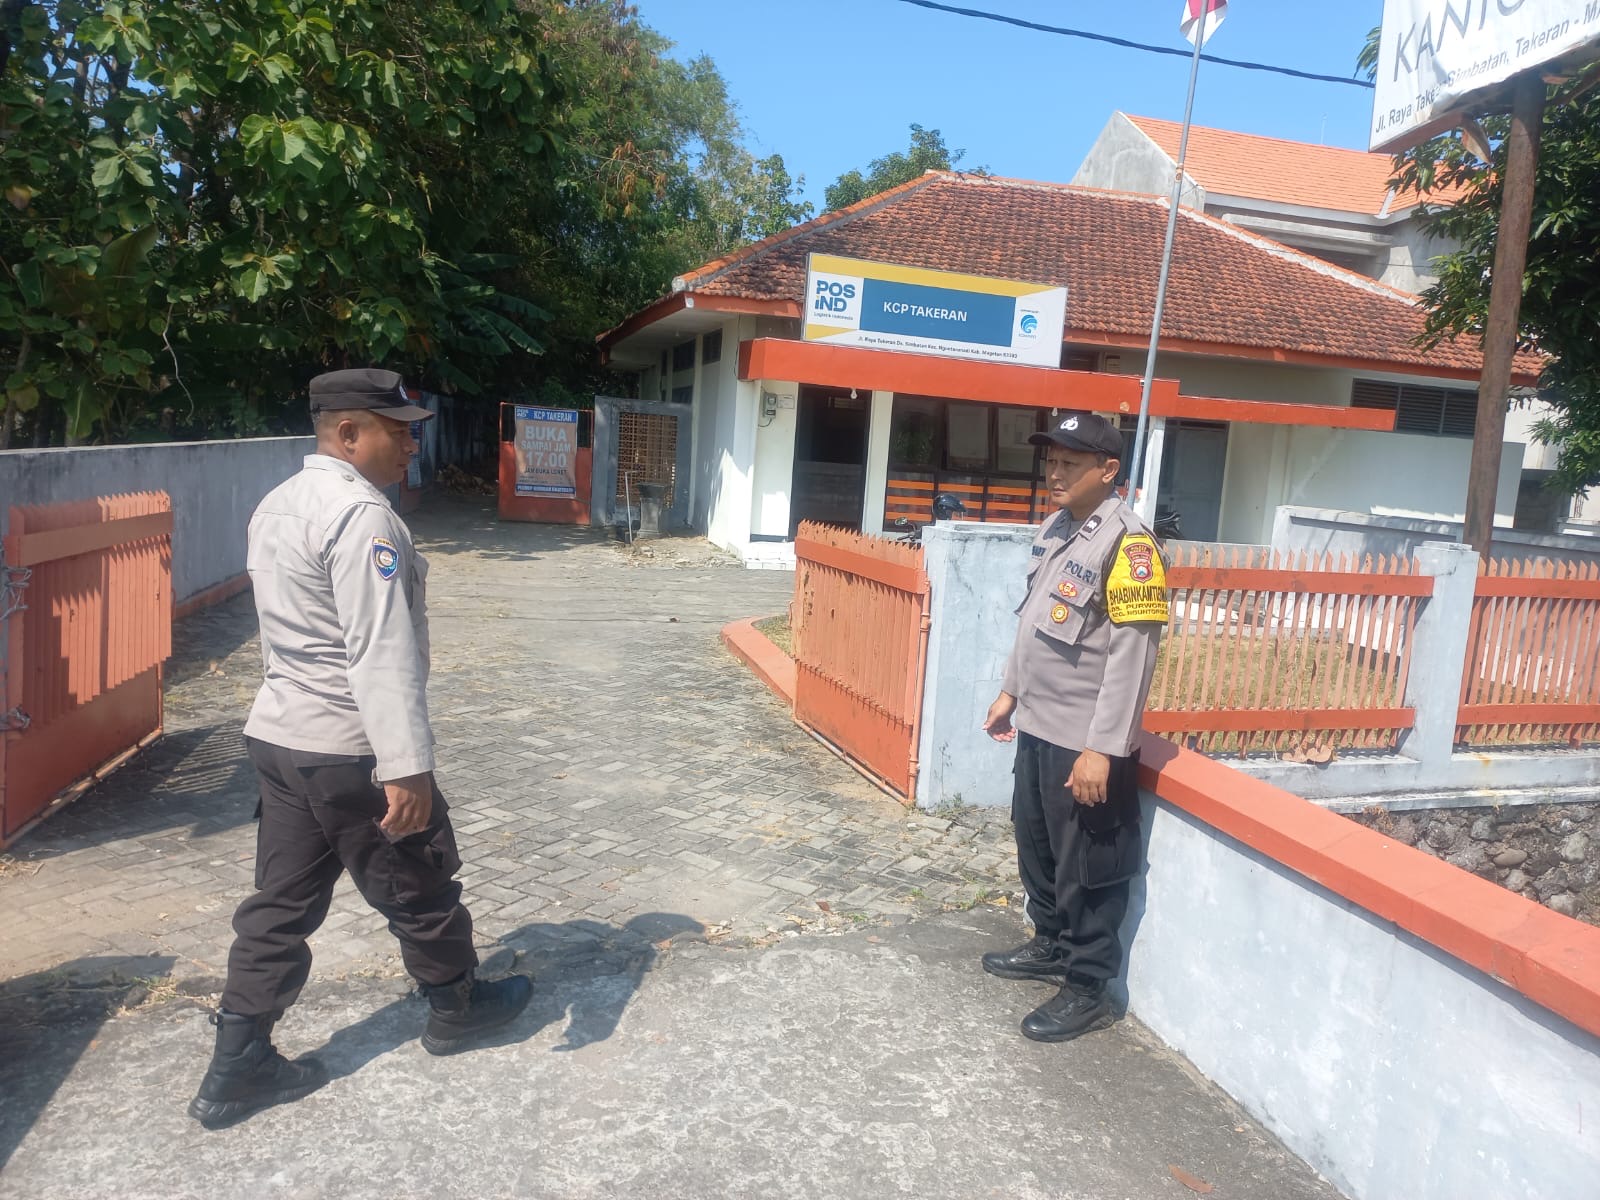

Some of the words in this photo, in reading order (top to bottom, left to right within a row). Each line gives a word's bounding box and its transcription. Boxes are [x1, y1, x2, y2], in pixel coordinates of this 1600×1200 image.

[1375, 115, 1386, 133] Jl.
[1388, 104, 1412, 127] Raya
[1515, 18, 1570, 59] Takeran
[816, 279, 856, 299] POS
[882, 301, 909, 315] KCP
[910, 305, 968, 322] TAKERAN
[864, 336, 877, 344] Raya
[533, 410, 546, 420] KCP
[546, 412, 573, 422] TAKERAN
[525, 425, 567, 441] BUKA
[521, 441, 552, 452] SAMPAI
[553, 442, 571, 453] JAM
[526, 451, 567, 468] 17.00
[1064, 560, 1099, 585] POLRI
